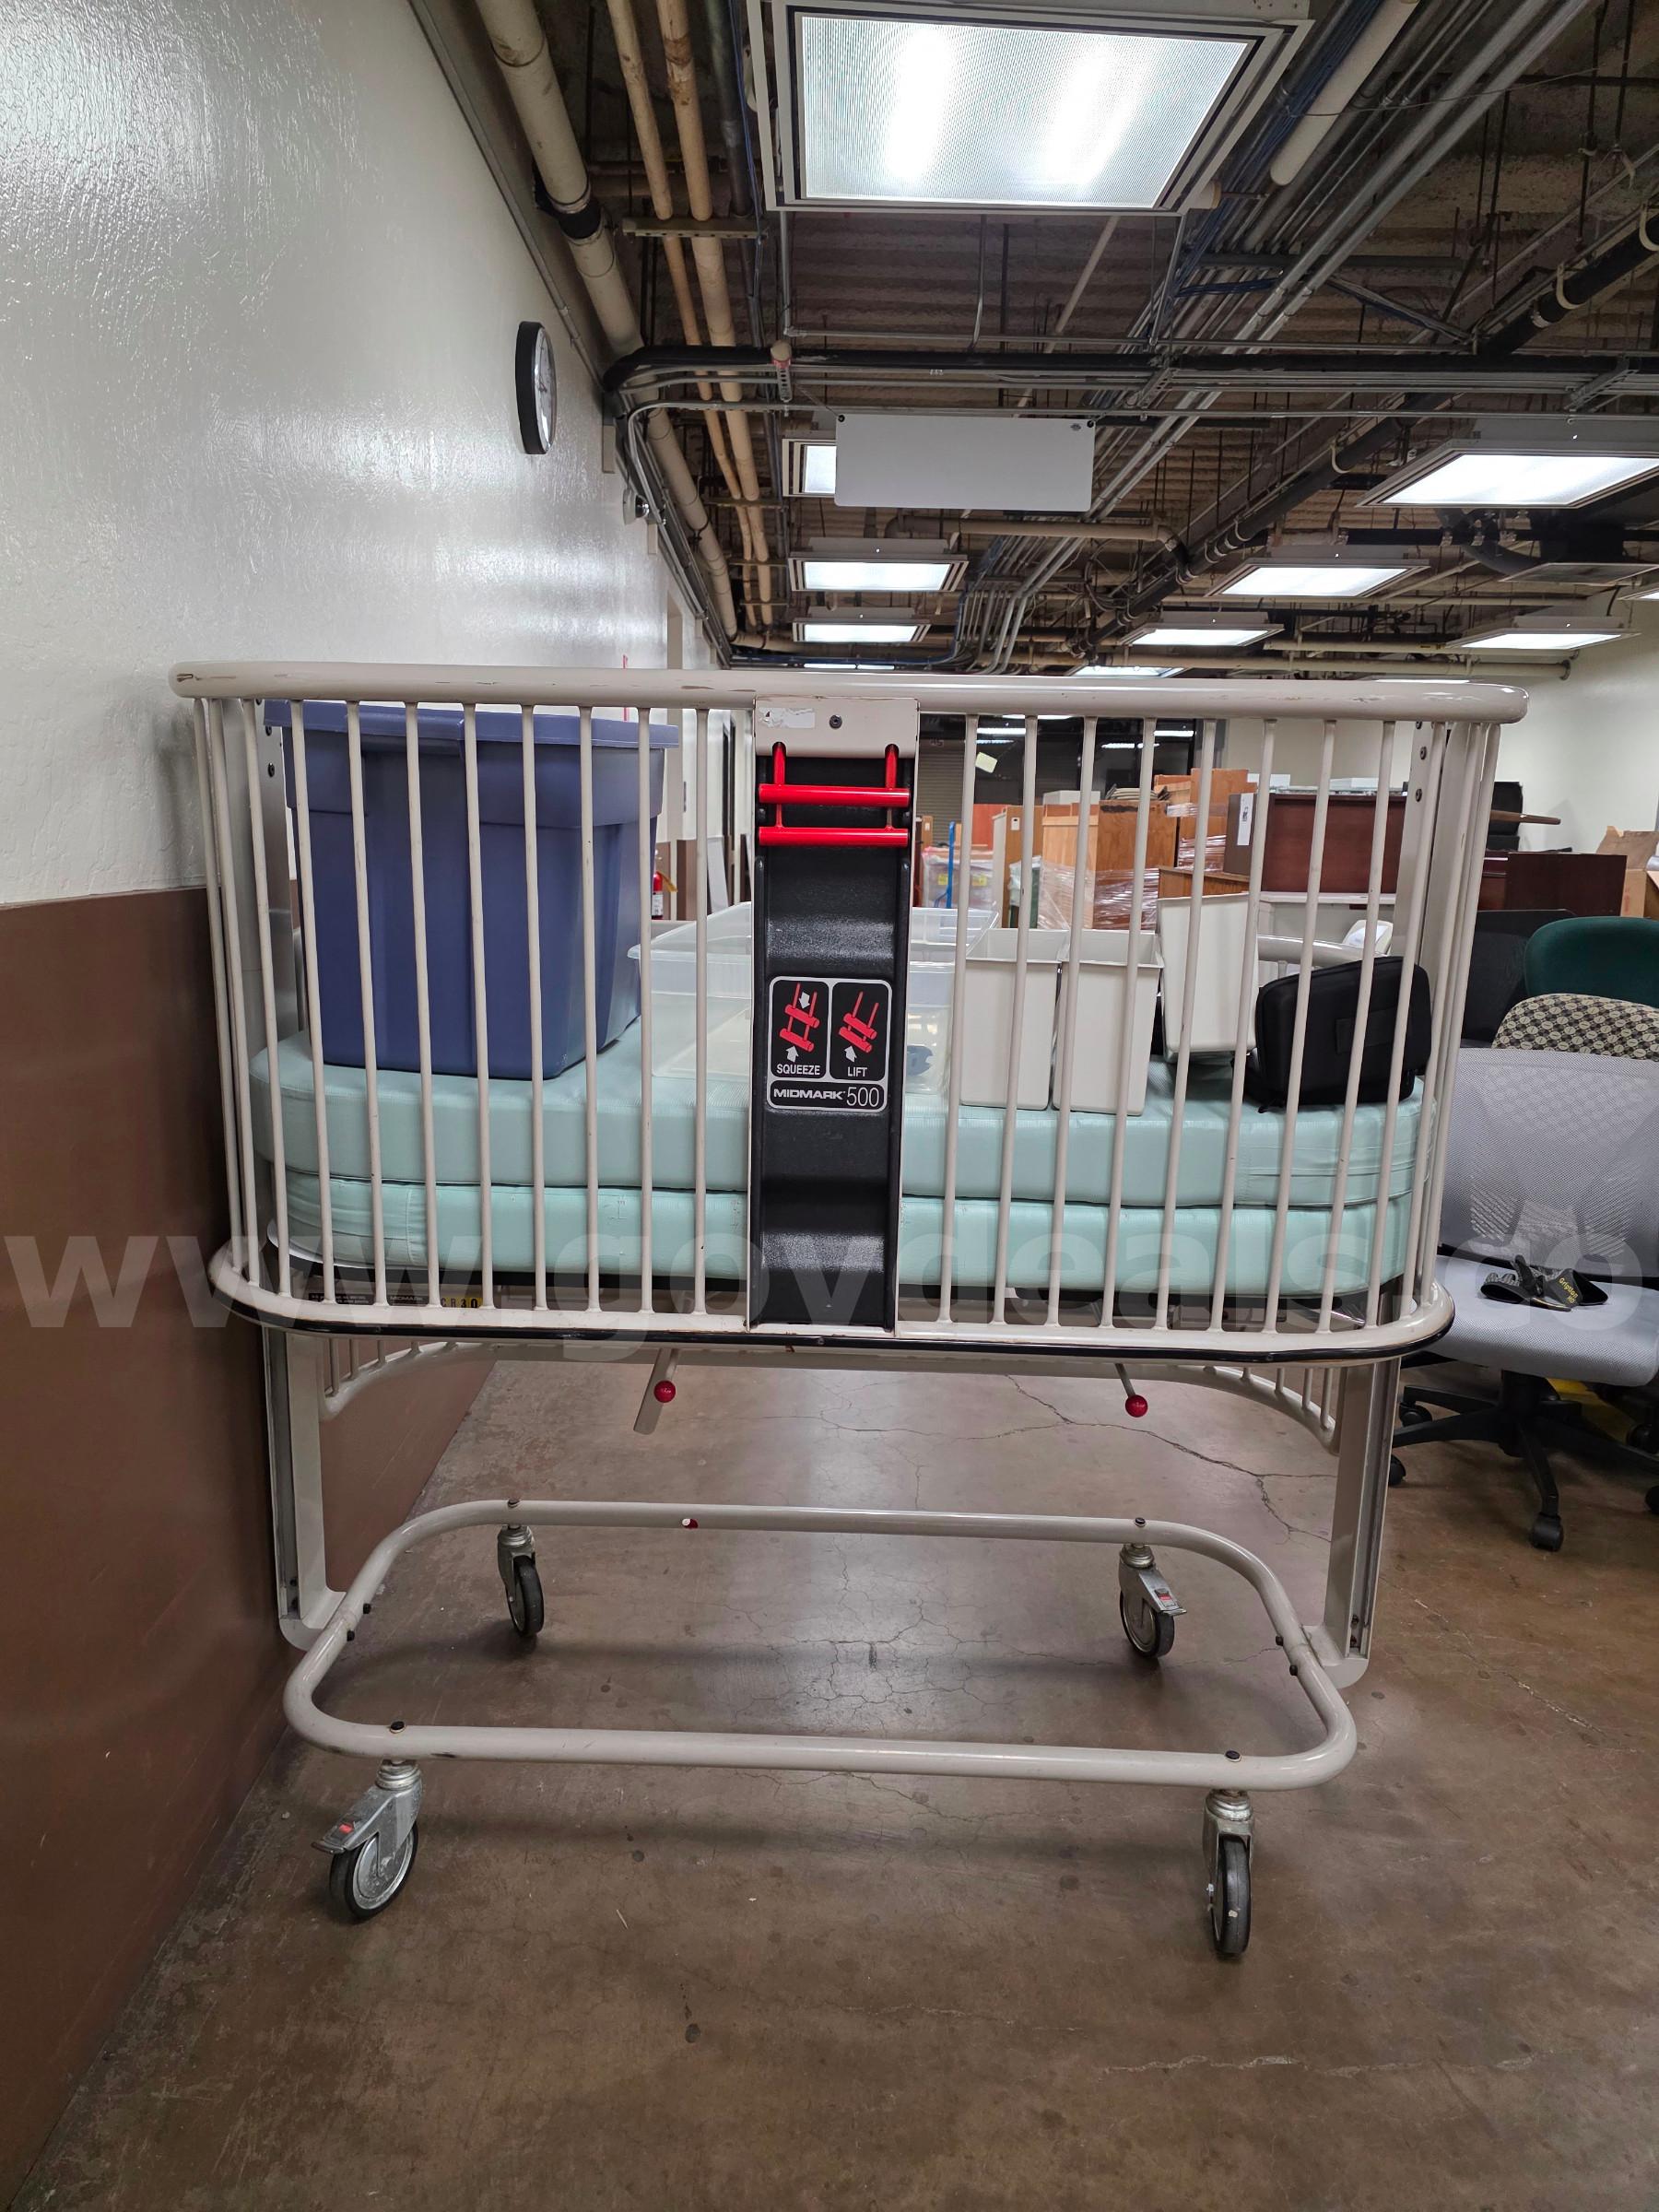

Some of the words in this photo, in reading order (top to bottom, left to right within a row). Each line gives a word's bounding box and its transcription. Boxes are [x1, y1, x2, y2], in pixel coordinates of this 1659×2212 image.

[776, 1063, 821, 1076] SQUEEZE
[847, 1066, 868, 1077] LIFT
[773, 1088, 843, 1100] MIDMARK
[846, 1087, 880, 1107] 500
